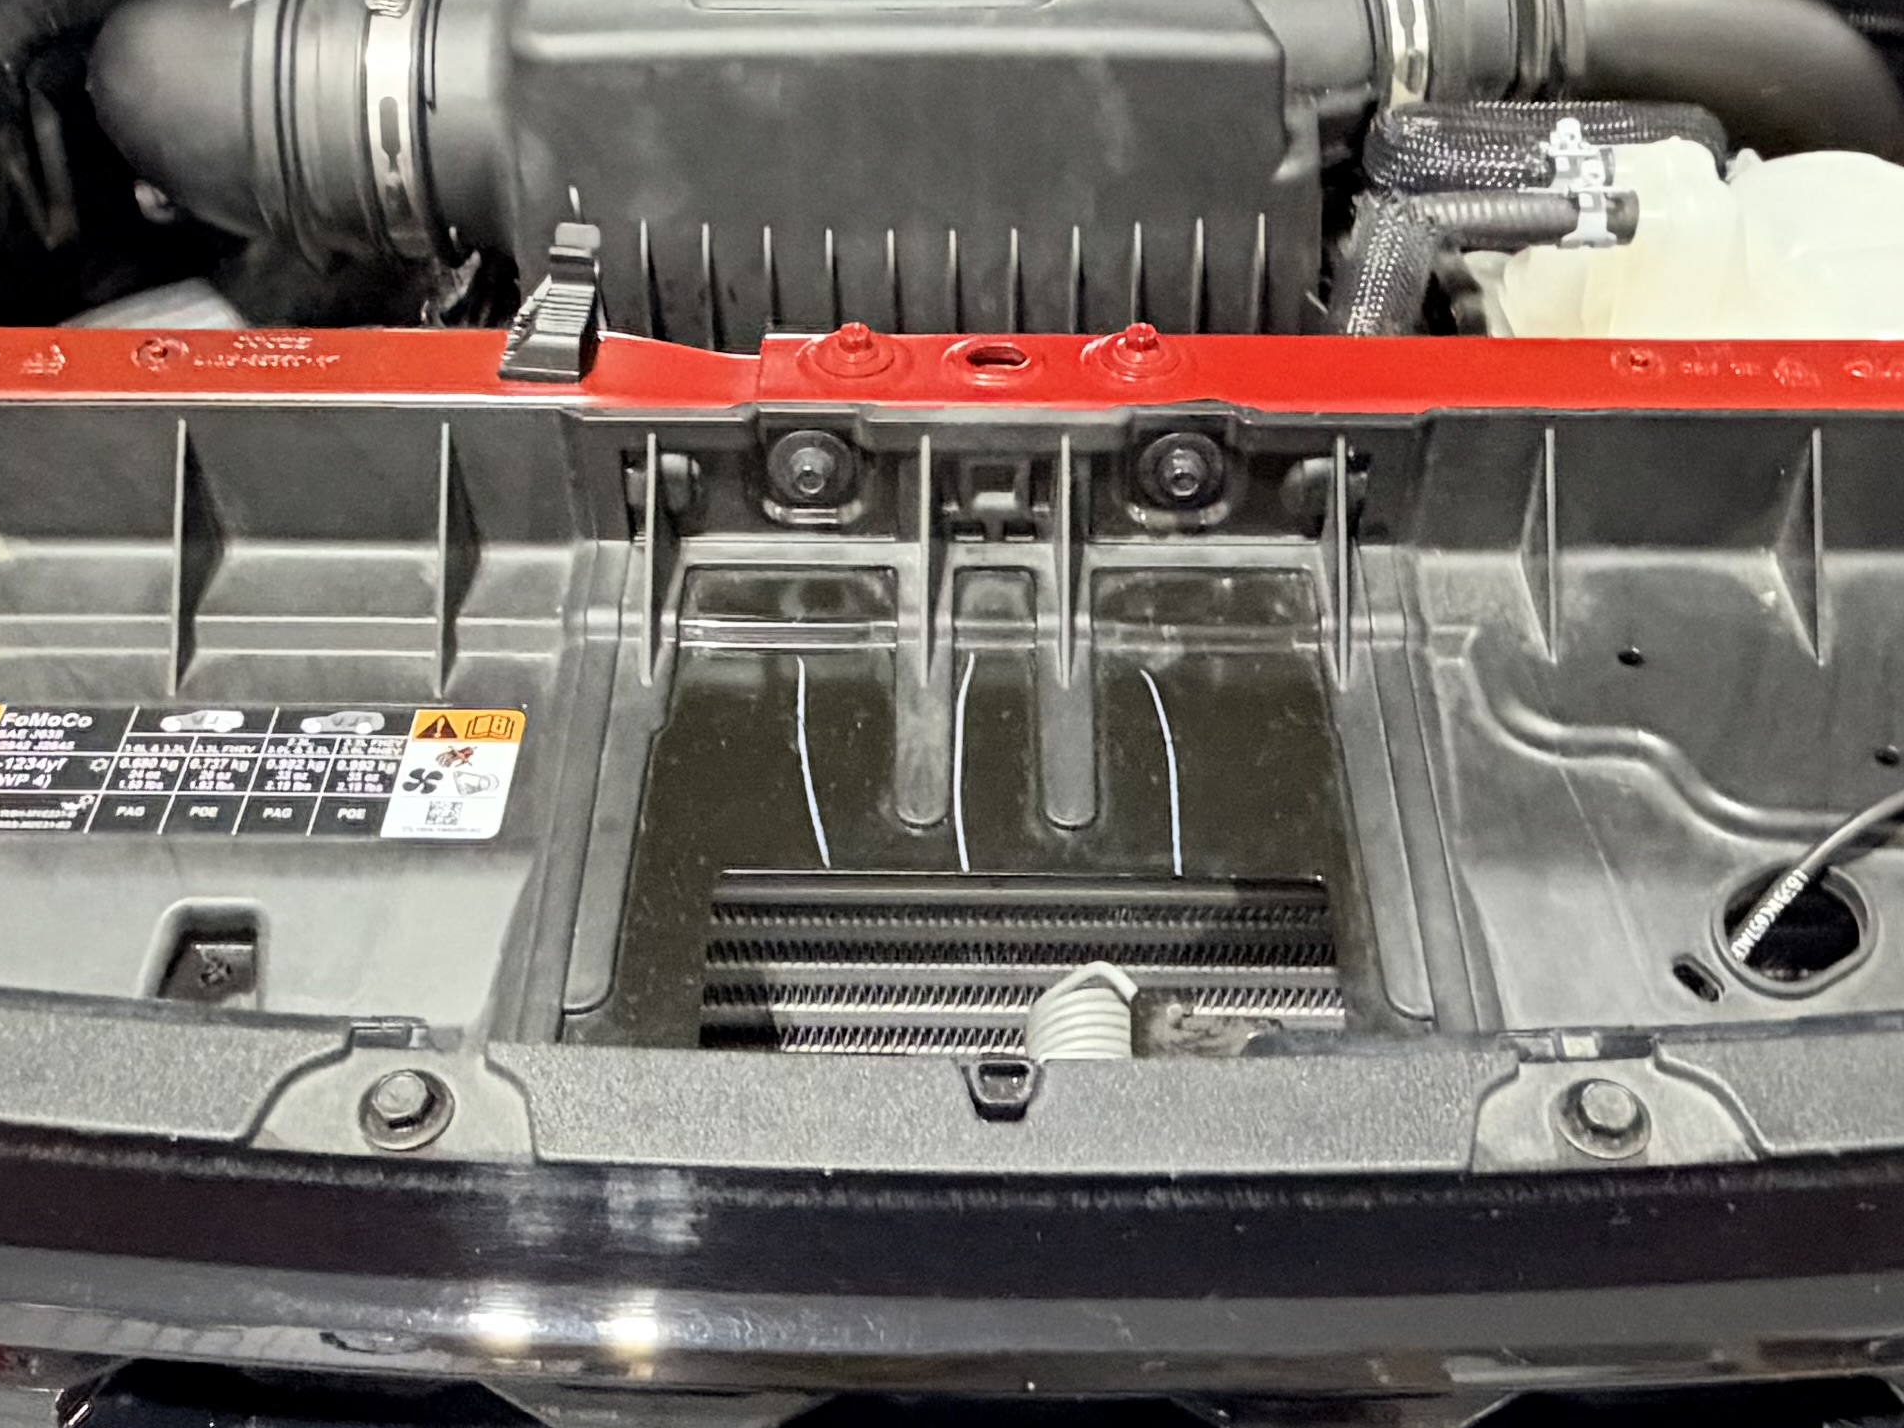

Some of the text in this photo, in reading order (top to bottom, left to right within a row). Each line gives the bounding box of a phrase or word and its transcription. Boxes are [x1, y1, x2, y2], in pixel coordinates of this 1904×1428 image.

[1, 713, 93, 728] FoMoCo
[160, 758, 180, 772] kg
[231, 759, 250, 773] kg
[307, 760, 326, 773] kg
[378, 760, 397, 774] kg
[32, 773, 52, 789] 4)
[115, 806, 145, 817] PAG
[189, 806, 219, 818] POE
[263, 807, 293, 819] PAG
[337, 807, 367, 820] POE
